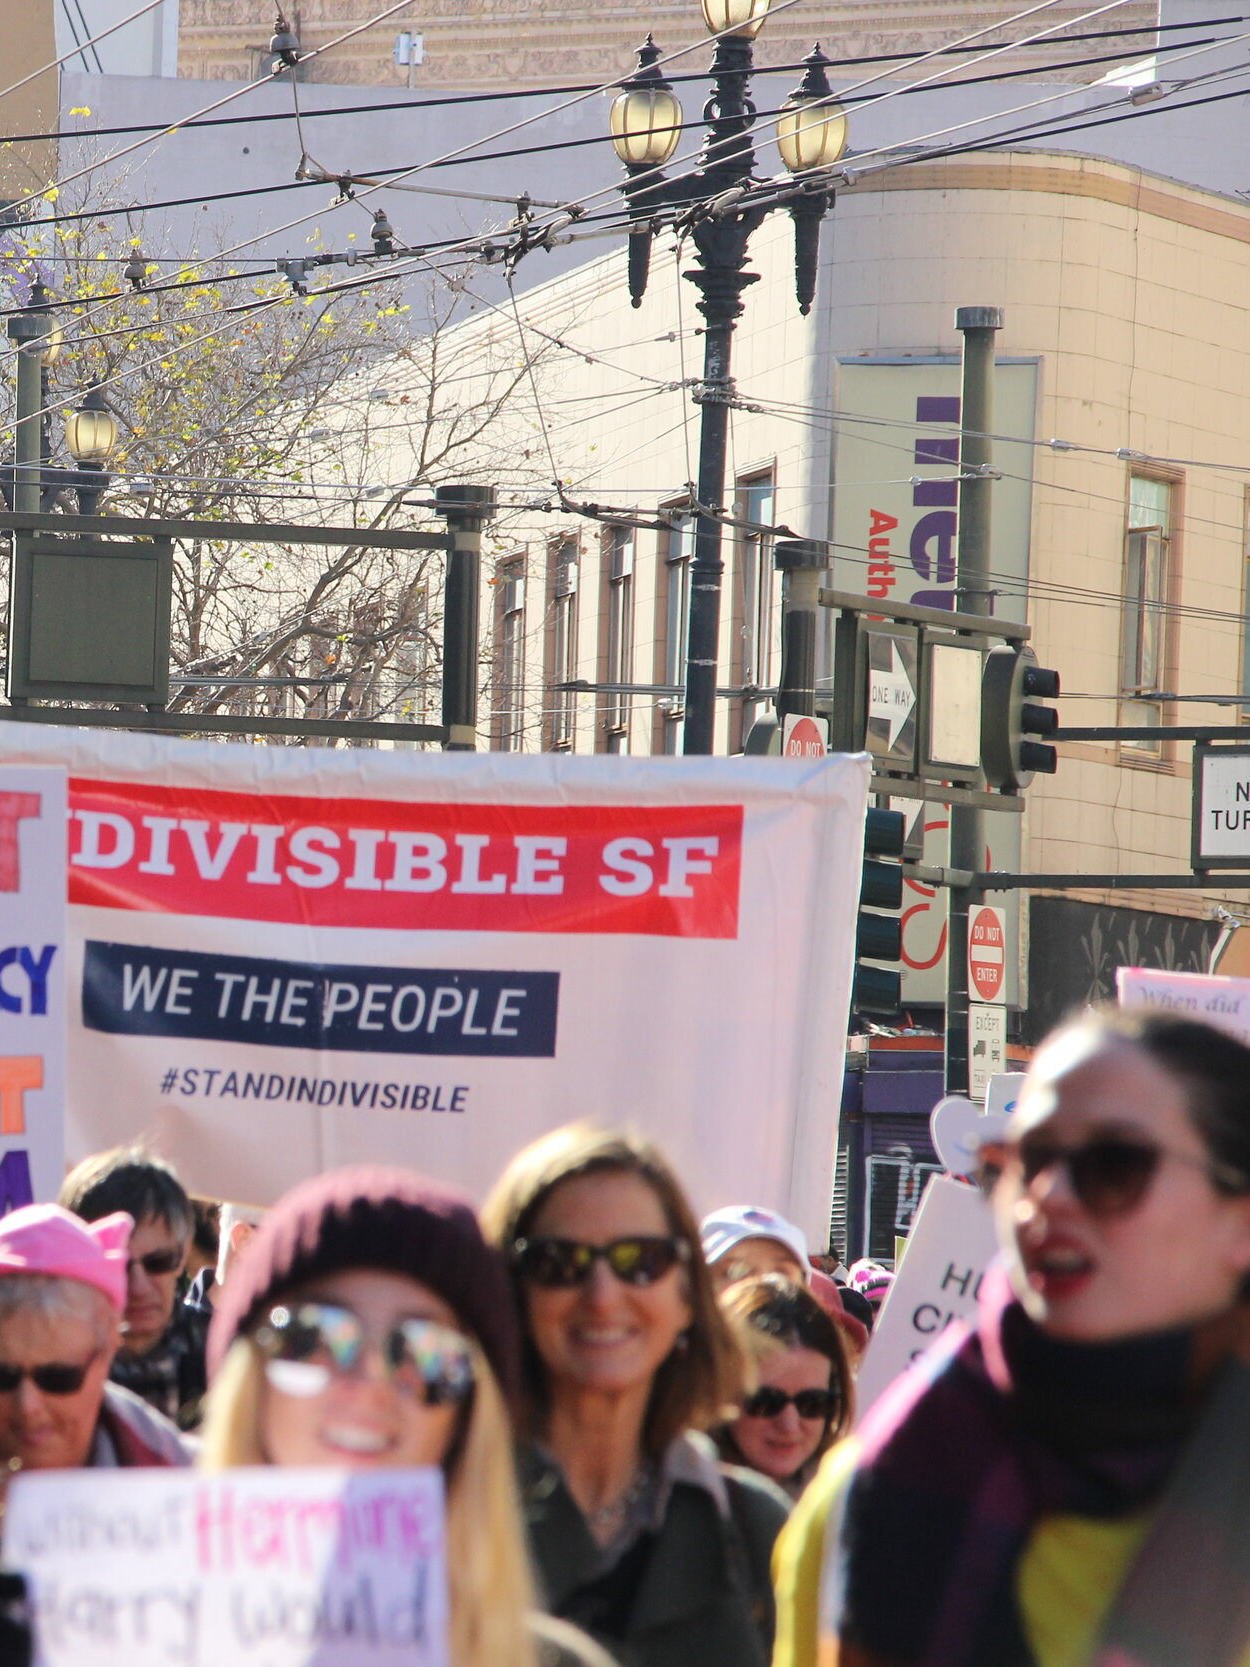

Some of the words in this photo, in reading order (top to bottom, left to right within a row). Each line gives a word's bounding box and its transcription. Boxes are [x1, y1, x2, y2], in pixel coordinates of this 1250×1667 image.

[872, 686, 888, 704] ONE
[894, 687, 912, 707] WAY
[790, 739, 801, 756] DO
[805, 742, 821, 757] NOT
[67, 808, 568, 896] DIVISIBLE
[598, 835, 720, 899] SF
[974, 925, 984, 939] DO
[986, 926, 1000, 941] NOT
[976, 966, 998, 983] ENTER
[122, 962, 199, 1015] WE
[214, 972, 315, 1027] THE
[323, 982, 528, 1037] PEOPLE
[975, 1016, 1000, 1032] EXCEPT
[160, 1068, 470, 1113] #STANDINDIVISIBLE
